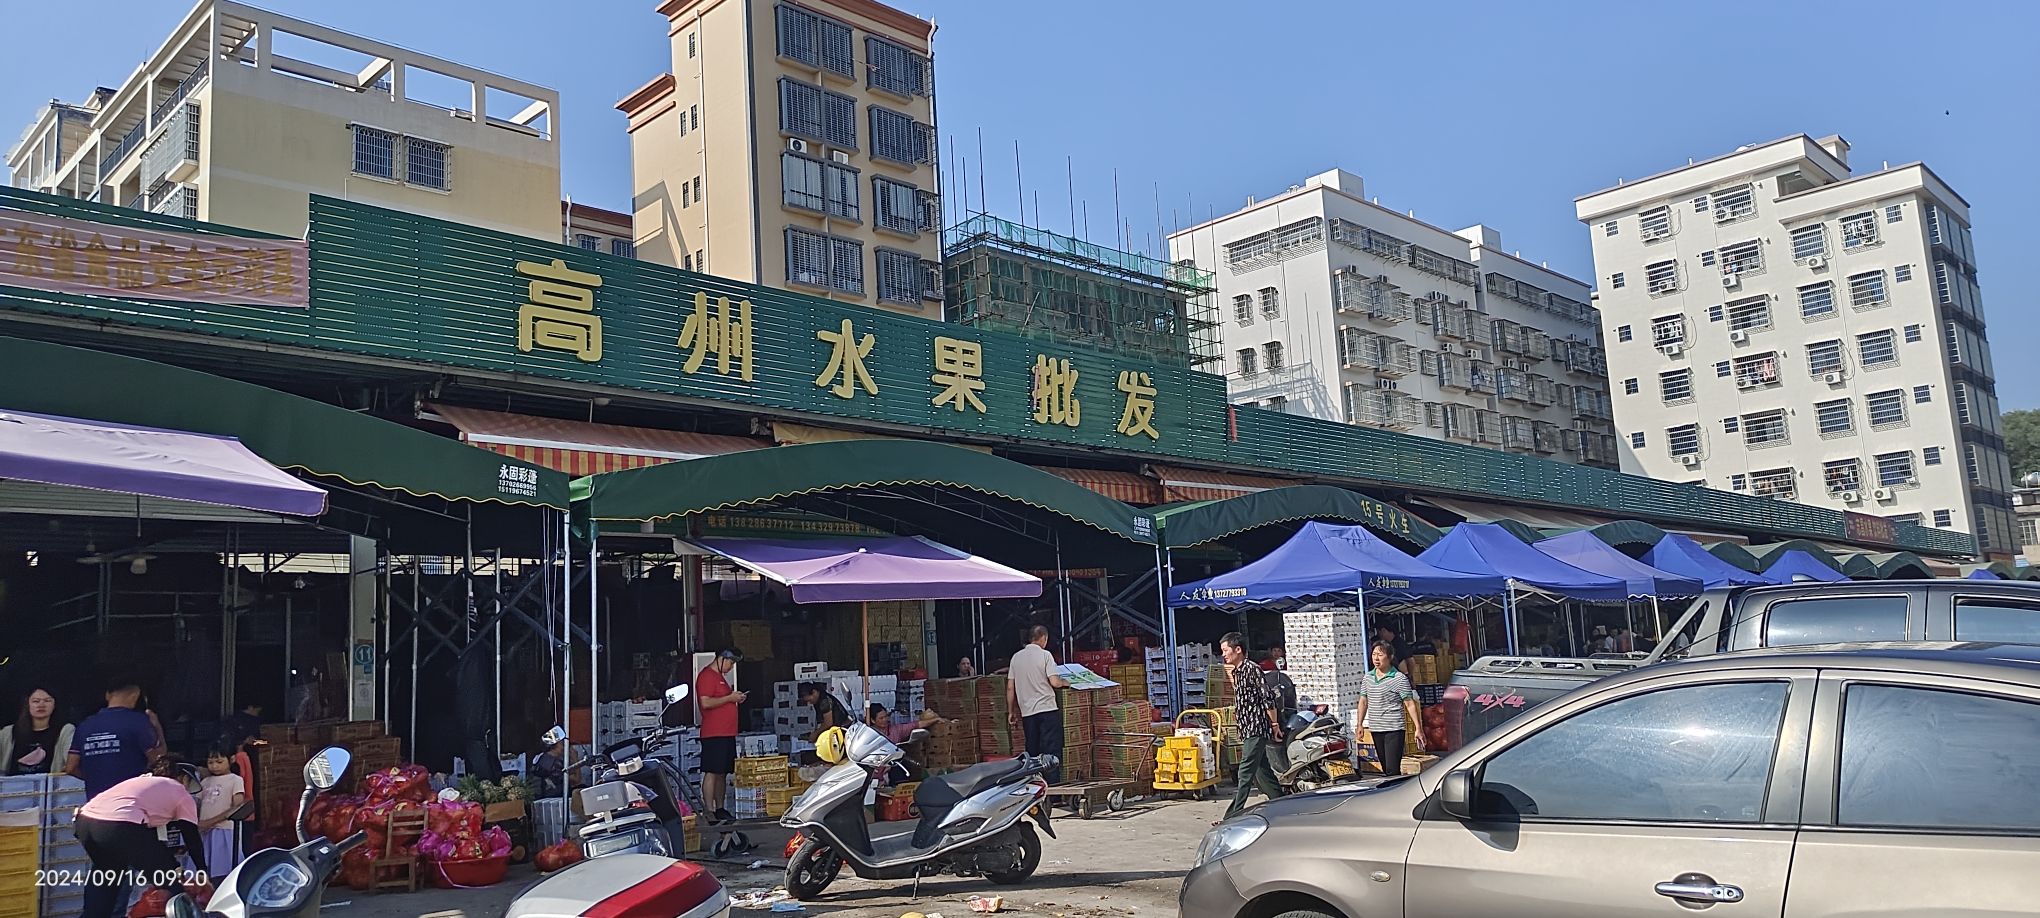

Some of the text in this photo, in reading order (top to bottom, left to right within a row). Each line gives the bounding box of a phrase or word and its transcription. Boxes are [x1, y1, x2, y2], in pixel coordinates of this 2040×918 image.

[0, 223, 294, 297] 东省食品安全示范县
[516, 258, 1160, 440] 高州水果批发
[707, 515, 727, 528] 电话
